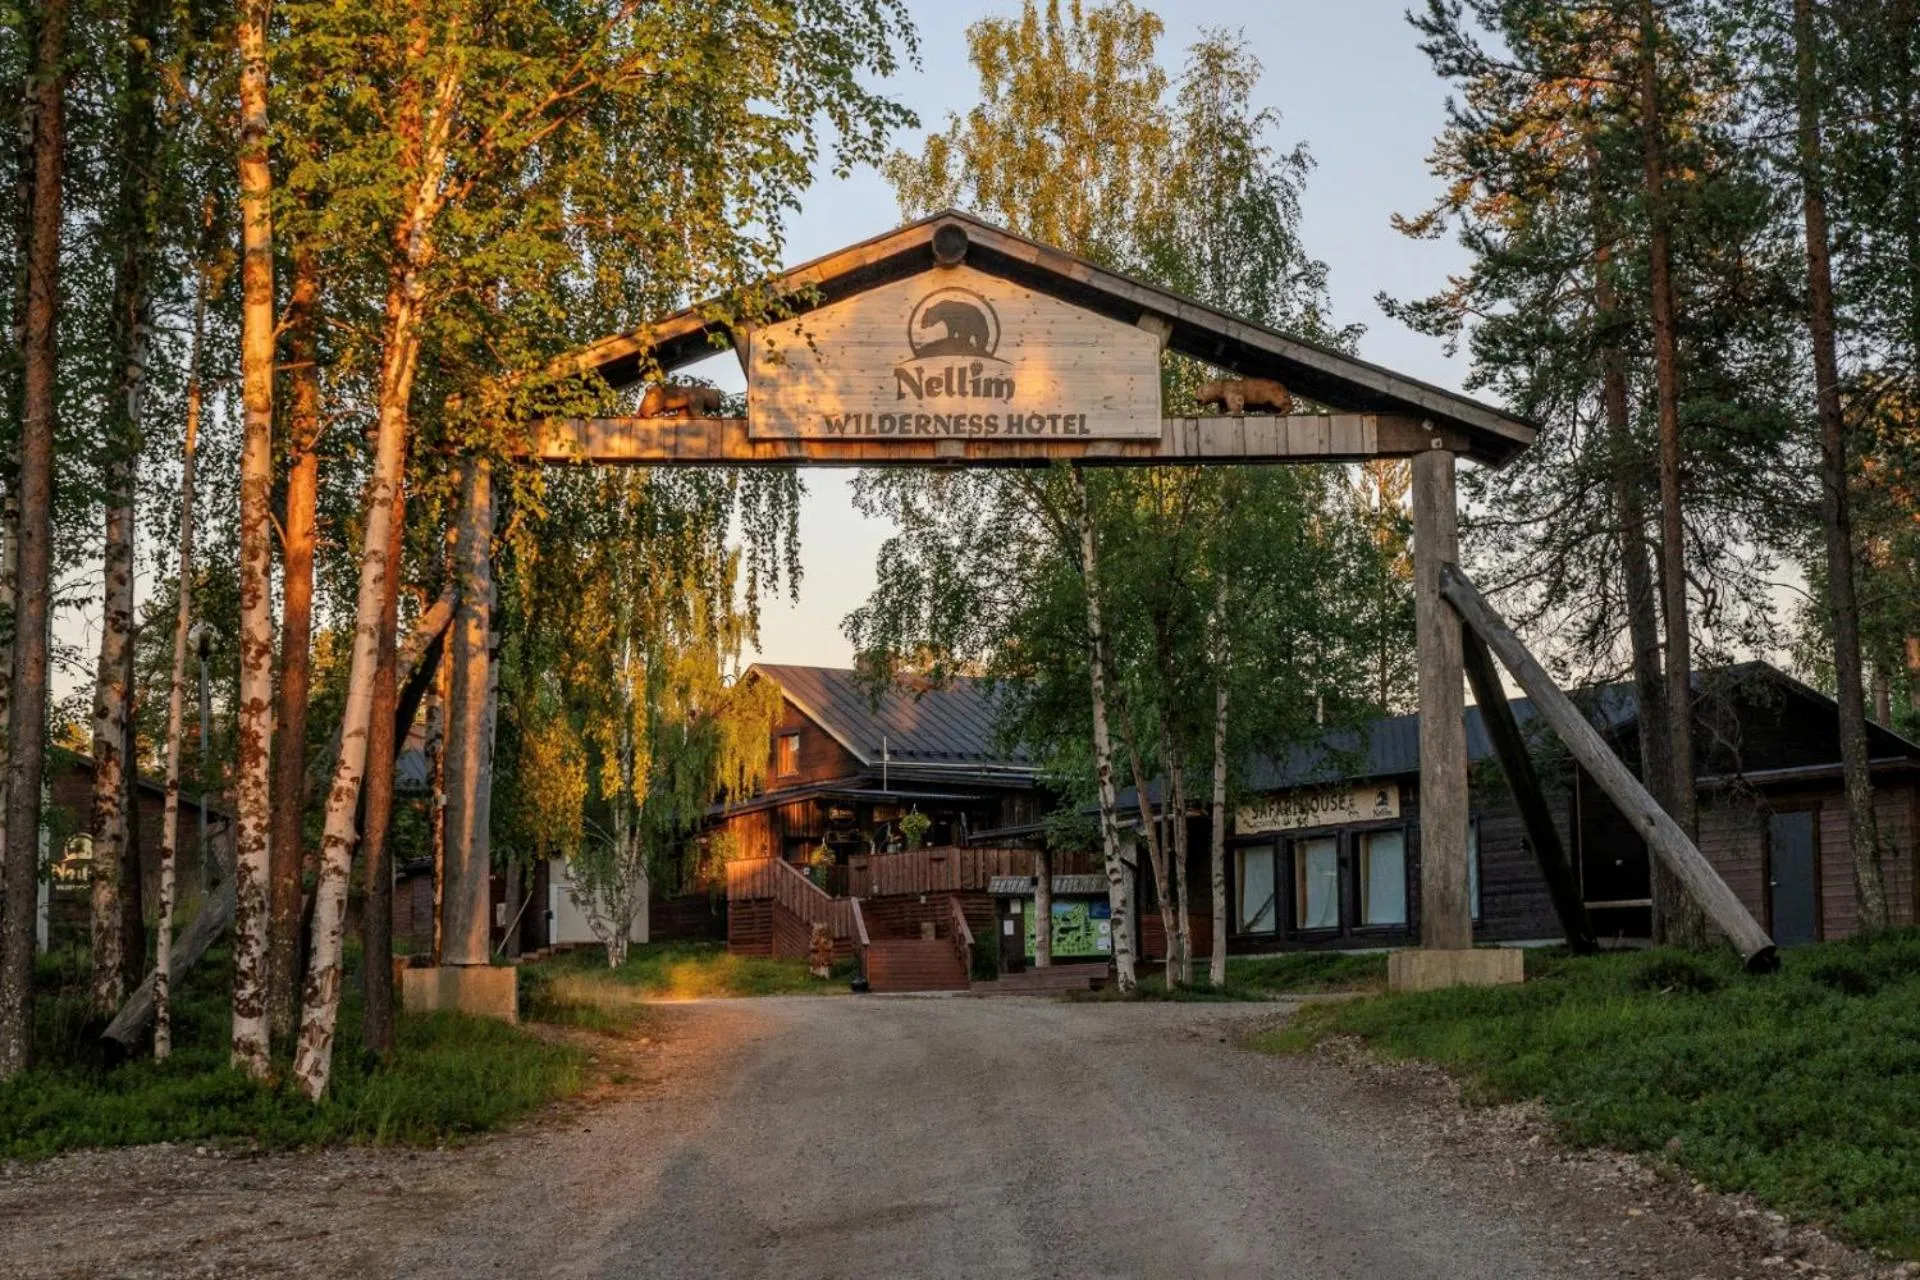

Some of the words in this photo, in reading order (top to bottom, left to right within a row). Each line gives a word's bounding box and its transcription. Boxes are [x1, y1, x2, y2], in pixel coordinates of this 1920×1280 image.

[893, 360, 1016, 403] Nellim
[824, 412, 999, 438] WILDERNESS
[1004, 410, 1090, 436] HOTEL
